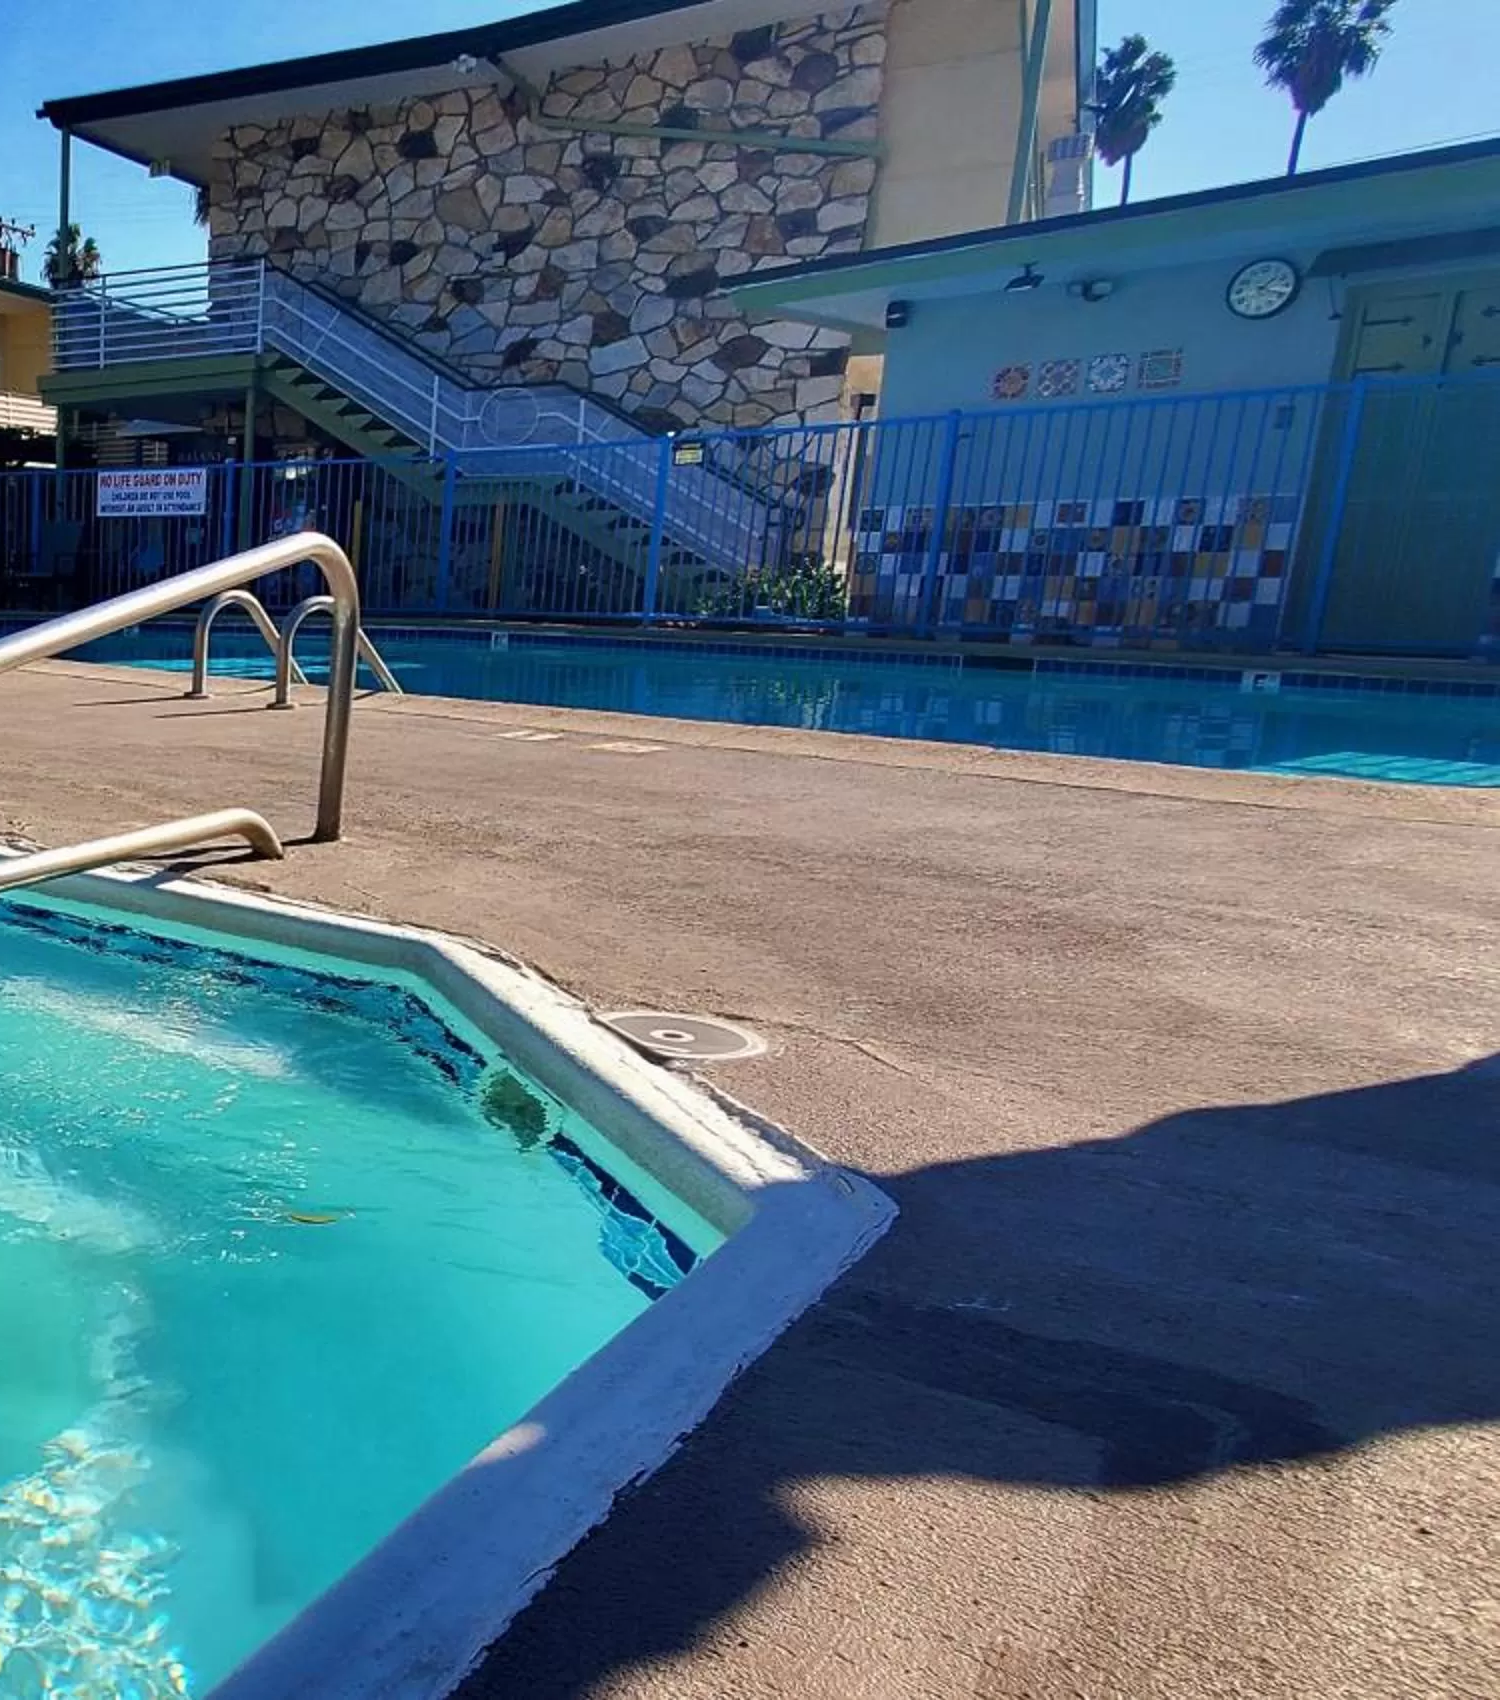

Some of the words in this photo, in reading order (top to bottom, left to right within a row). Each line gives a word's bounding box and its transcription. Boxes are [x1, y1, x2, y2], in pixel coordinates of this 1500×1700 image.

[114, 474, 130, 487] LIFE
[133, 473, 162, 486] GUARD
[164, 473, 176, 486] ON
[178, 472, 203, 485] DUTY
